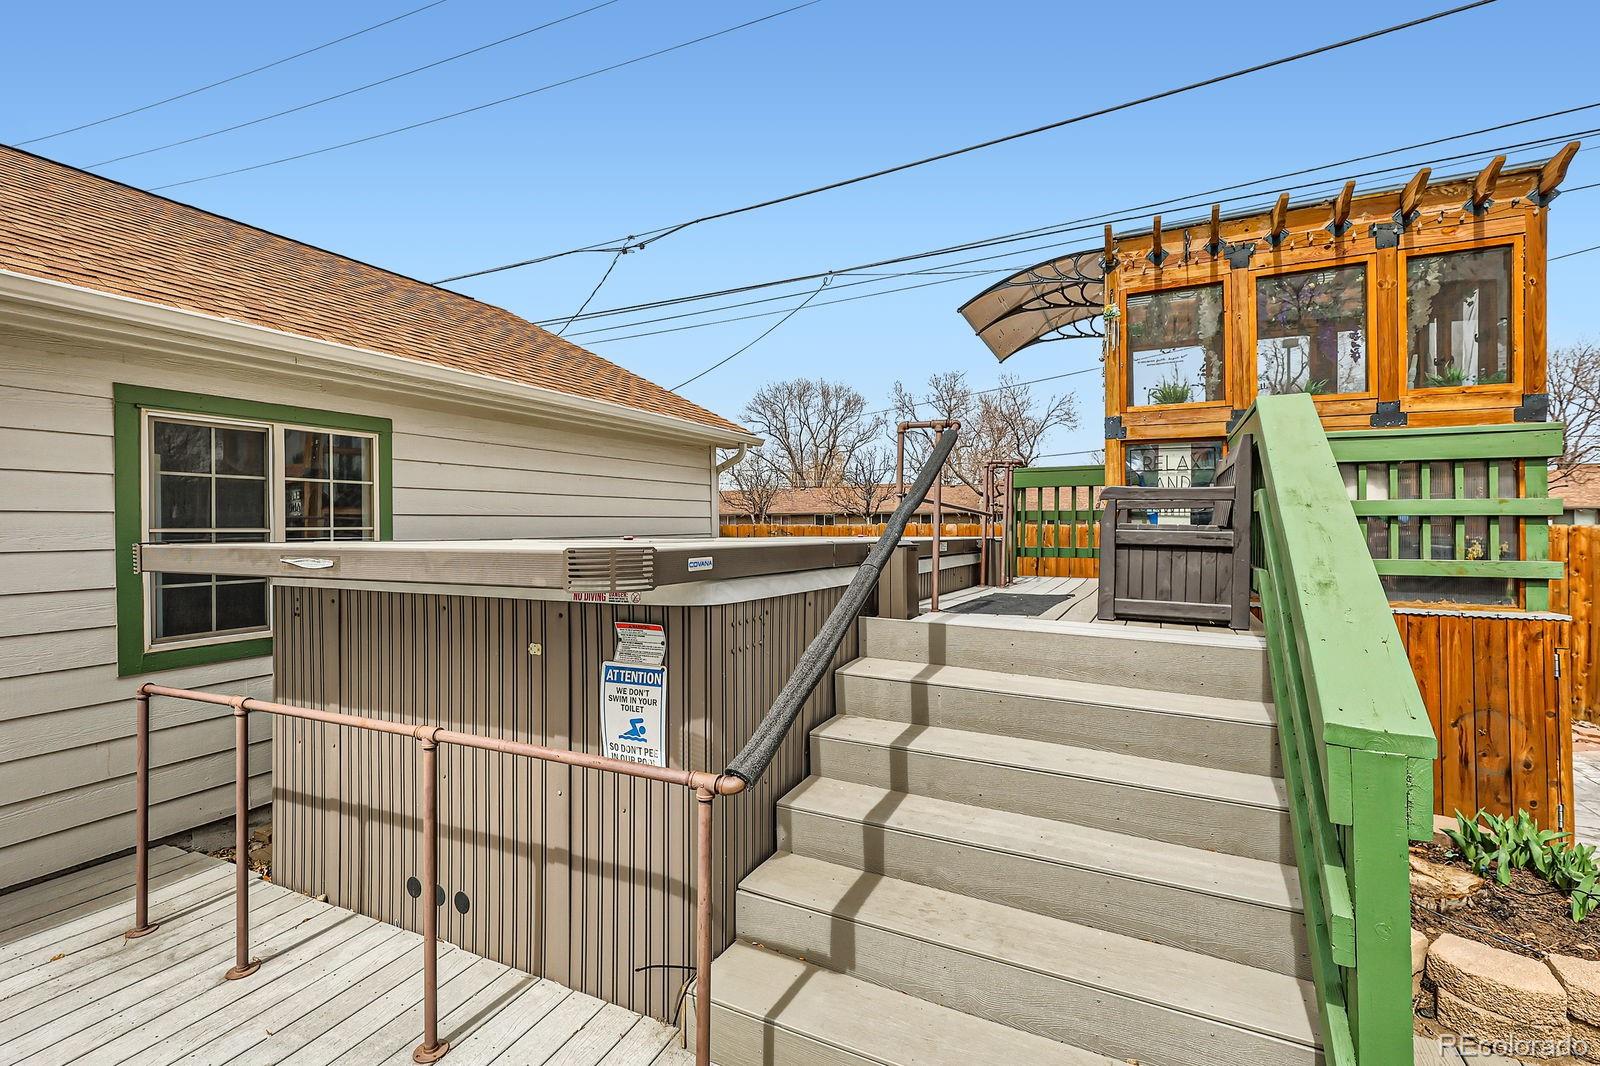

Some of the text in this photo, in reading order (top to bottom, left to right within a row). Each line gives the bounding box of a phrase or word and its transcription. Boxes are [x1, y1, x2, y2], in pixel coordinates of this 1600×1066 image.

[1143, 451, 1201, 471] RELAX
[1157, 475, 1192, 488] AND
[688, 559, 712, 568] COVANA
[573, 592, 583, 601] NO
[584, 592, 607, 602] DIVING
[606, 668, 662, 685] ATTENTION
[616, 687, 650, 697] WE DON'T
[608, 694, 658, 706] SWIM IN YOUR
[620, 704, 645, 713] TOILET
[609, 742, 619, 751] SO
[621, 744, 643, 755] DON'T
[611, 752, 619, 760] IN
[620, 754, 636, 763] OUR
